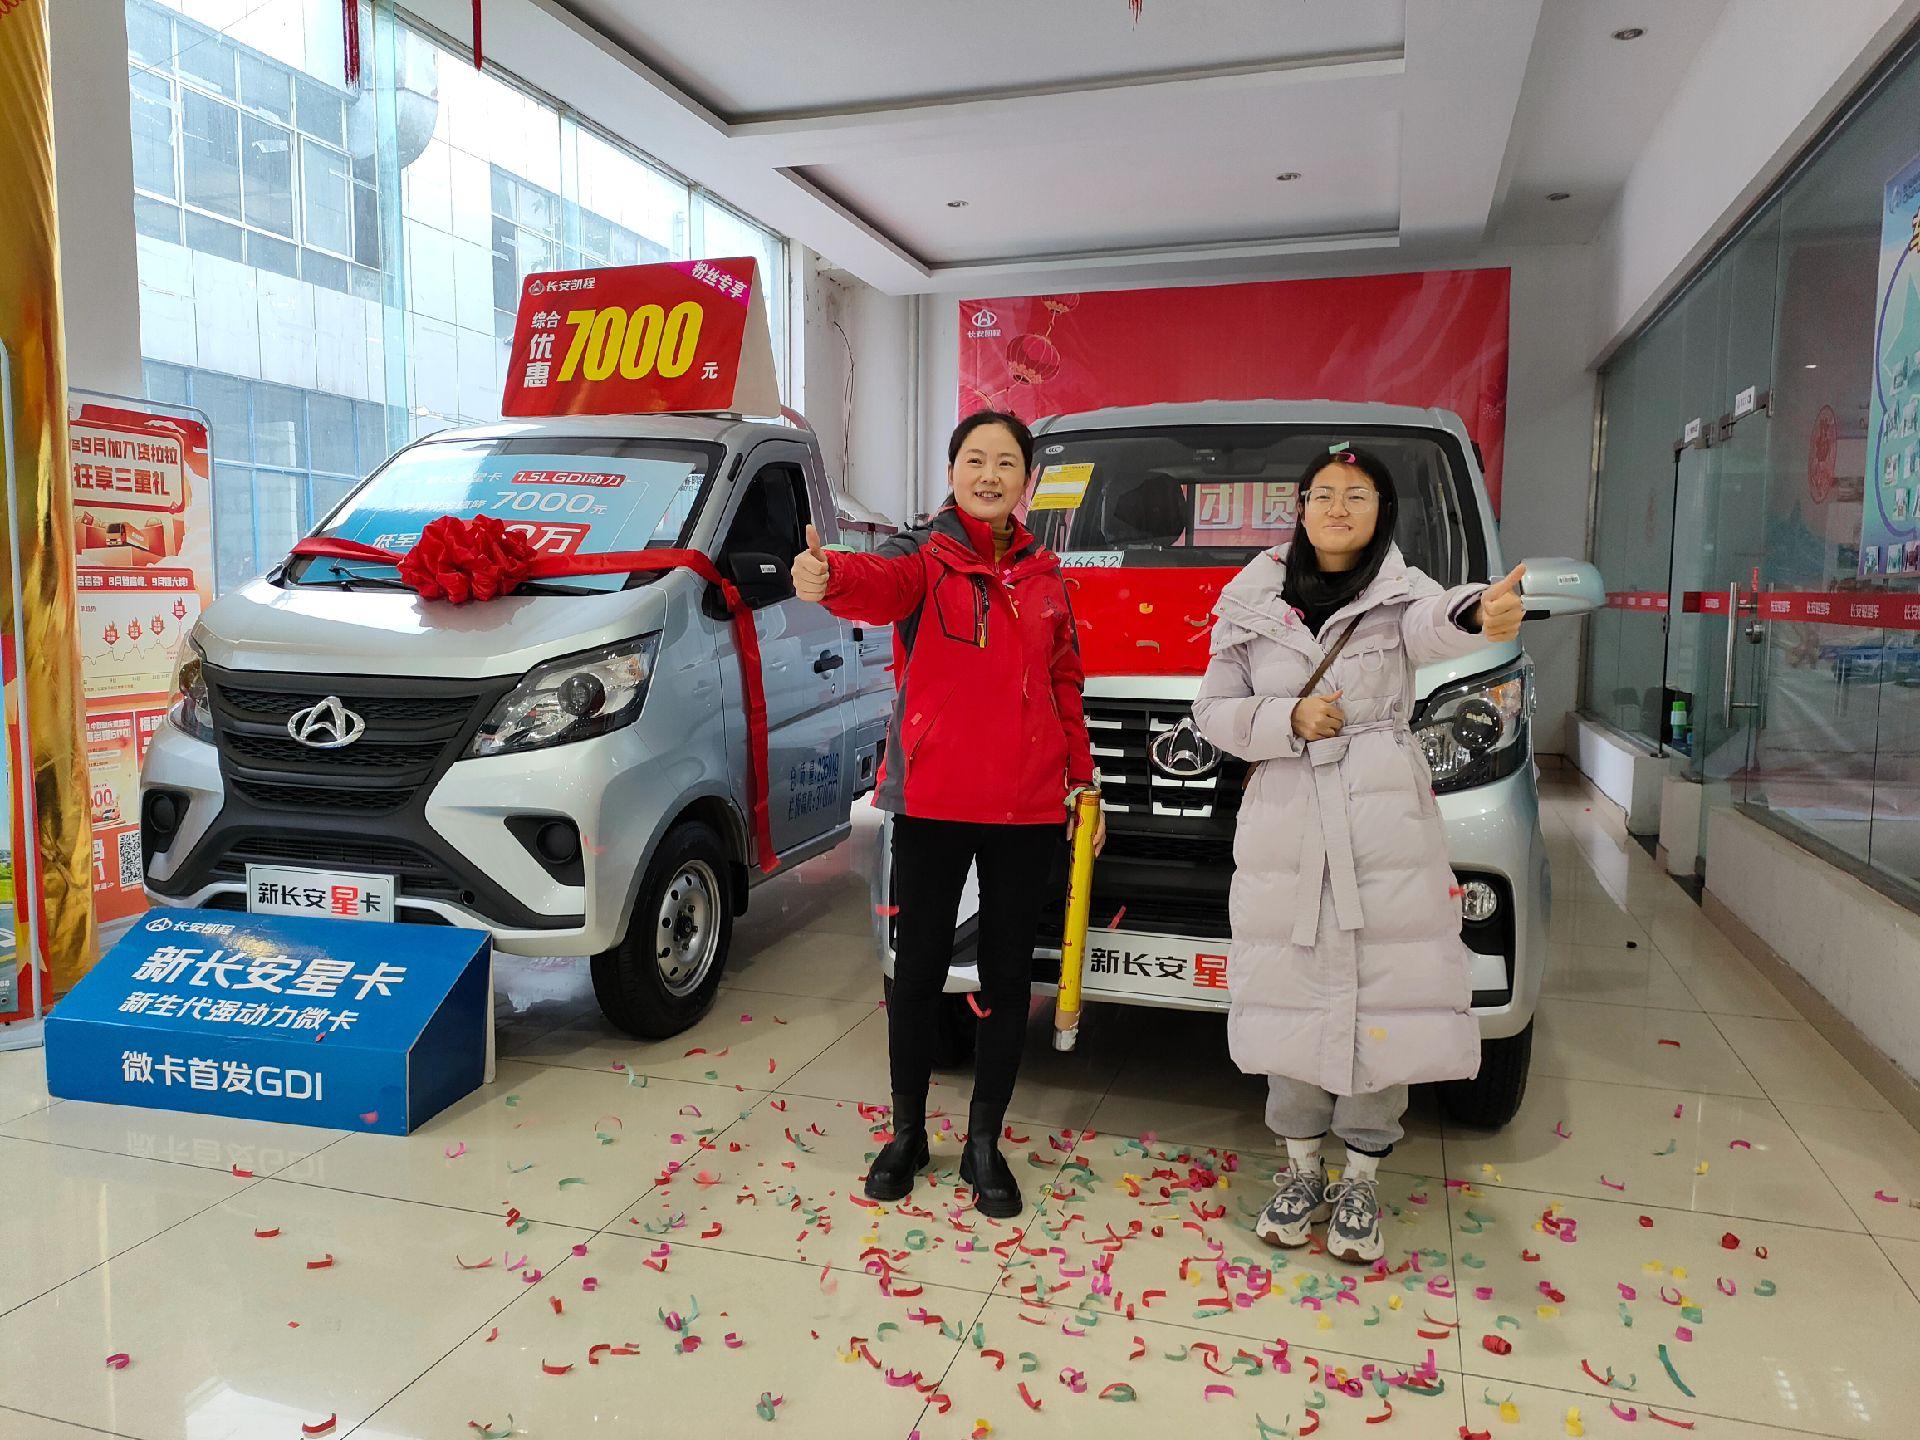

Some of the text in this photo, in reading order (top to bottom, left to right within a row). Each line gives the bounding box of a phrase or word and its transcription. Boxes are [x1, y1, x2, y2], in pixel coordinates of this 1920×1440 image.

[546, 276, 596, 293] 长安凯程
[691, 260, 748, 299] 粉丝专享
[530, 310, 562, 330] 综合
[523, 333, 556, 389] 优惠
[556, 301, 704, 382] 7000
[701, 361, 719, 381] 元
[258, 882, 381, 917] 新长安星卡
[131, 945, 408, 1002] 新长安星卡
[1090, 947, 1229, 991] 新长安星
[117, 991, 360, 1033] 新生代强动力微卡
[121, 1050, 323, 1102] 微卡首发GDI
